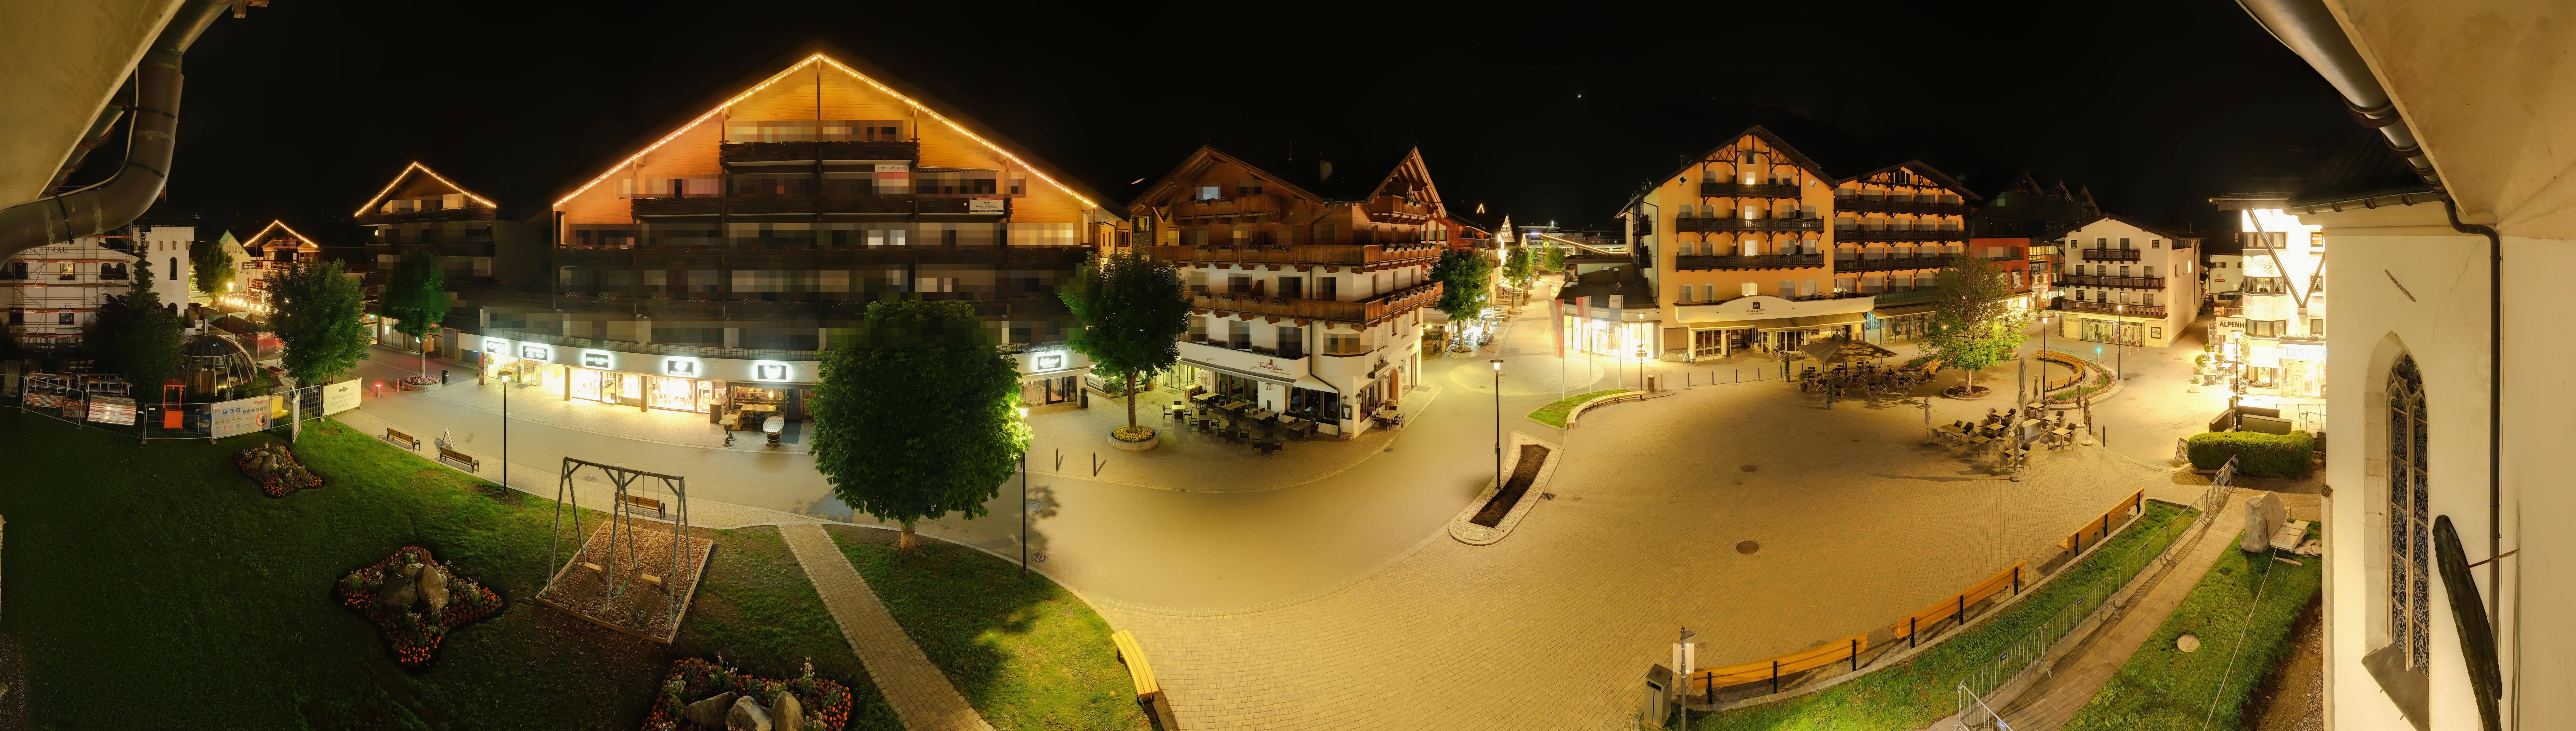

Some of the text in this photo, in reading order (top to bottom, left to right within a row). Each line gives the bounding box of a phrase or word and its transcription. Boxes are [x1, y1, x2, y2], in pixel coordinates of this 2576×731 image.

[1406, 343, 1414, 351] SAILER
[1375, 364, 1389, 377] RESTAURANT
[331, 396, 354, 405] KONGRESSZENTRUM
